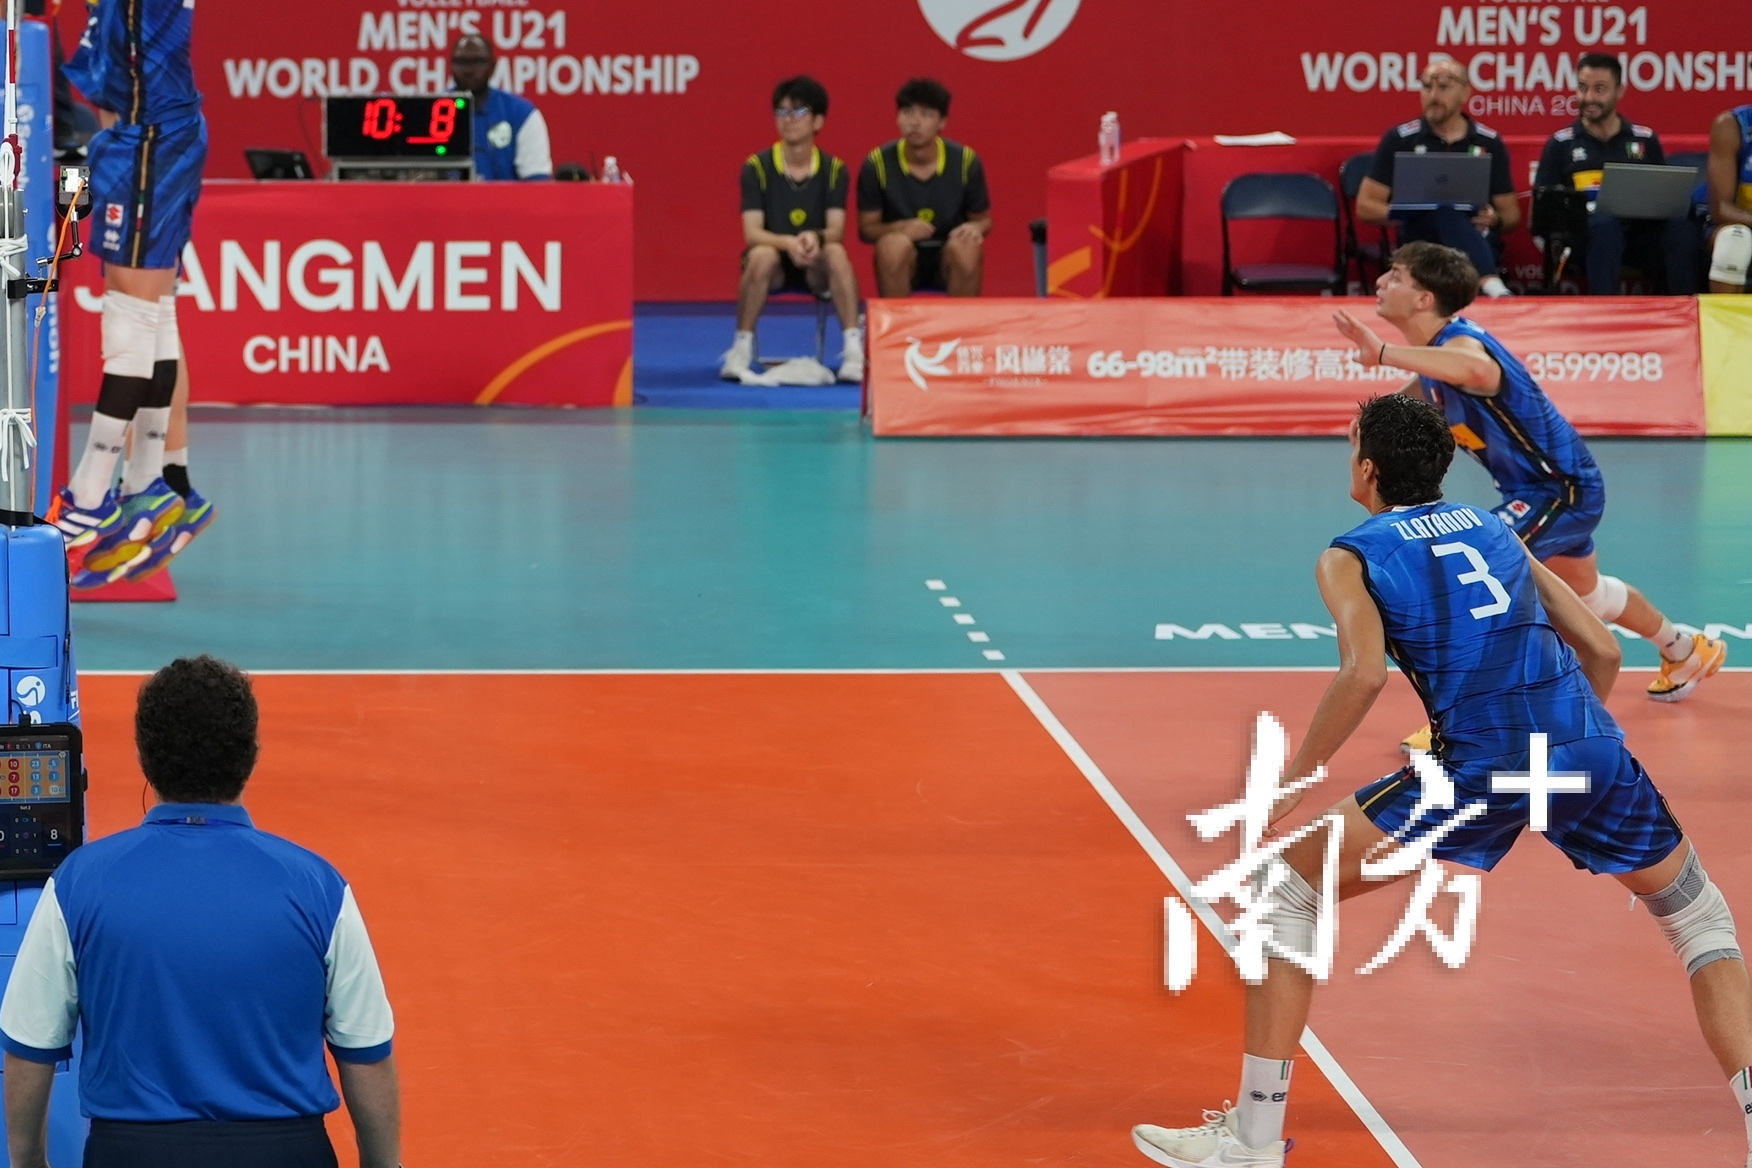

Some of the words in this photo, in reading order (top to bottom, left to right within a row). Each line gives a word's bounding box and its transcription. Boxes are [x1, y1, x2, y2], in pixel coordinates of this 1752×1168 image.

[357, 11, 484, 51] MEN'S
[492, 9, 566, 49] U21
[1436, 5, 1561, 46] MEN'S
[1573, 5, 1647, 45] U21
[223, 57, 380, 98] WORLD
[1468, 95, 1546, 117] CHINA
[242, 335, 391, 373] CHINA
[1389, 507, 1484, 541] ZLATANOV
[1430, 541, 1512, 620] 3
[9, 759, 18, 768] 10
[10, 786, 18, 794] 17
[50, 828, 58, 840] 8
